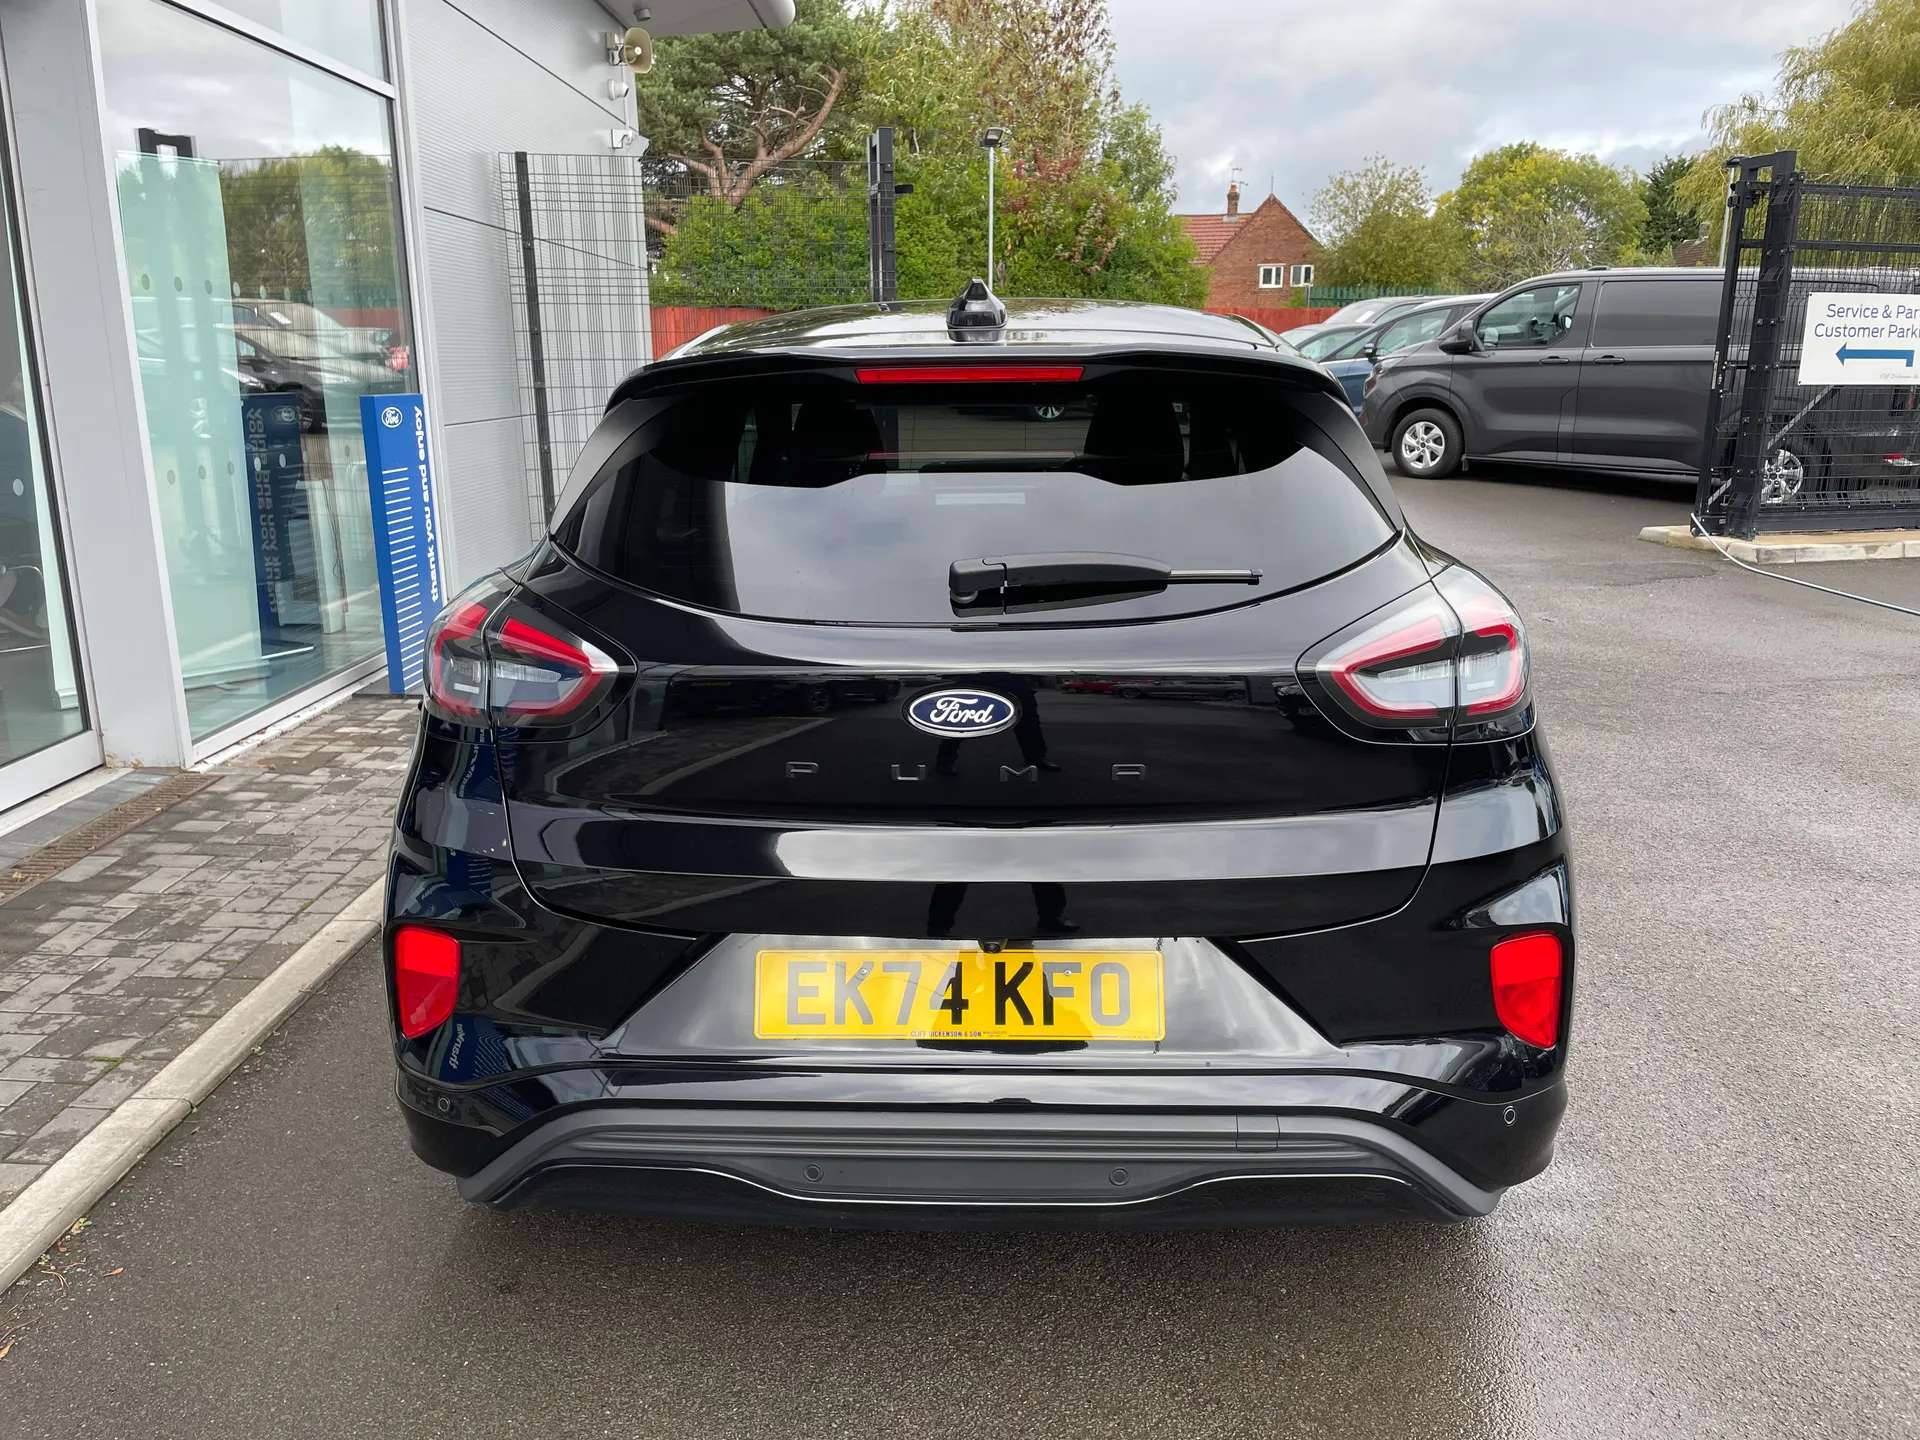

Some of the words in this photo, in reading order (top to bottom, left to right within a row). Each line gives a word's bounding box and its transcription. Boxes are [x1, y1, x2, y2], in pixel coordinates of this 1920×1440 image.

[1826, 303, 1879, 318] Service
[1882, 304, 1893, 319] &
[1814, 323, 1884, 338] Customer
[414, 405, 426, 461] enjoy
[418, 464, 430, 503] and
[424, 506, 434, 543] you
[427, 544, 439, 602] thank
[929, 696, 993, 724] Ford
[785, 761, 1146, 782] PUMA
[786, 960, 969, 1026] EK74
[994, 960, 1132, 1026] KFO
